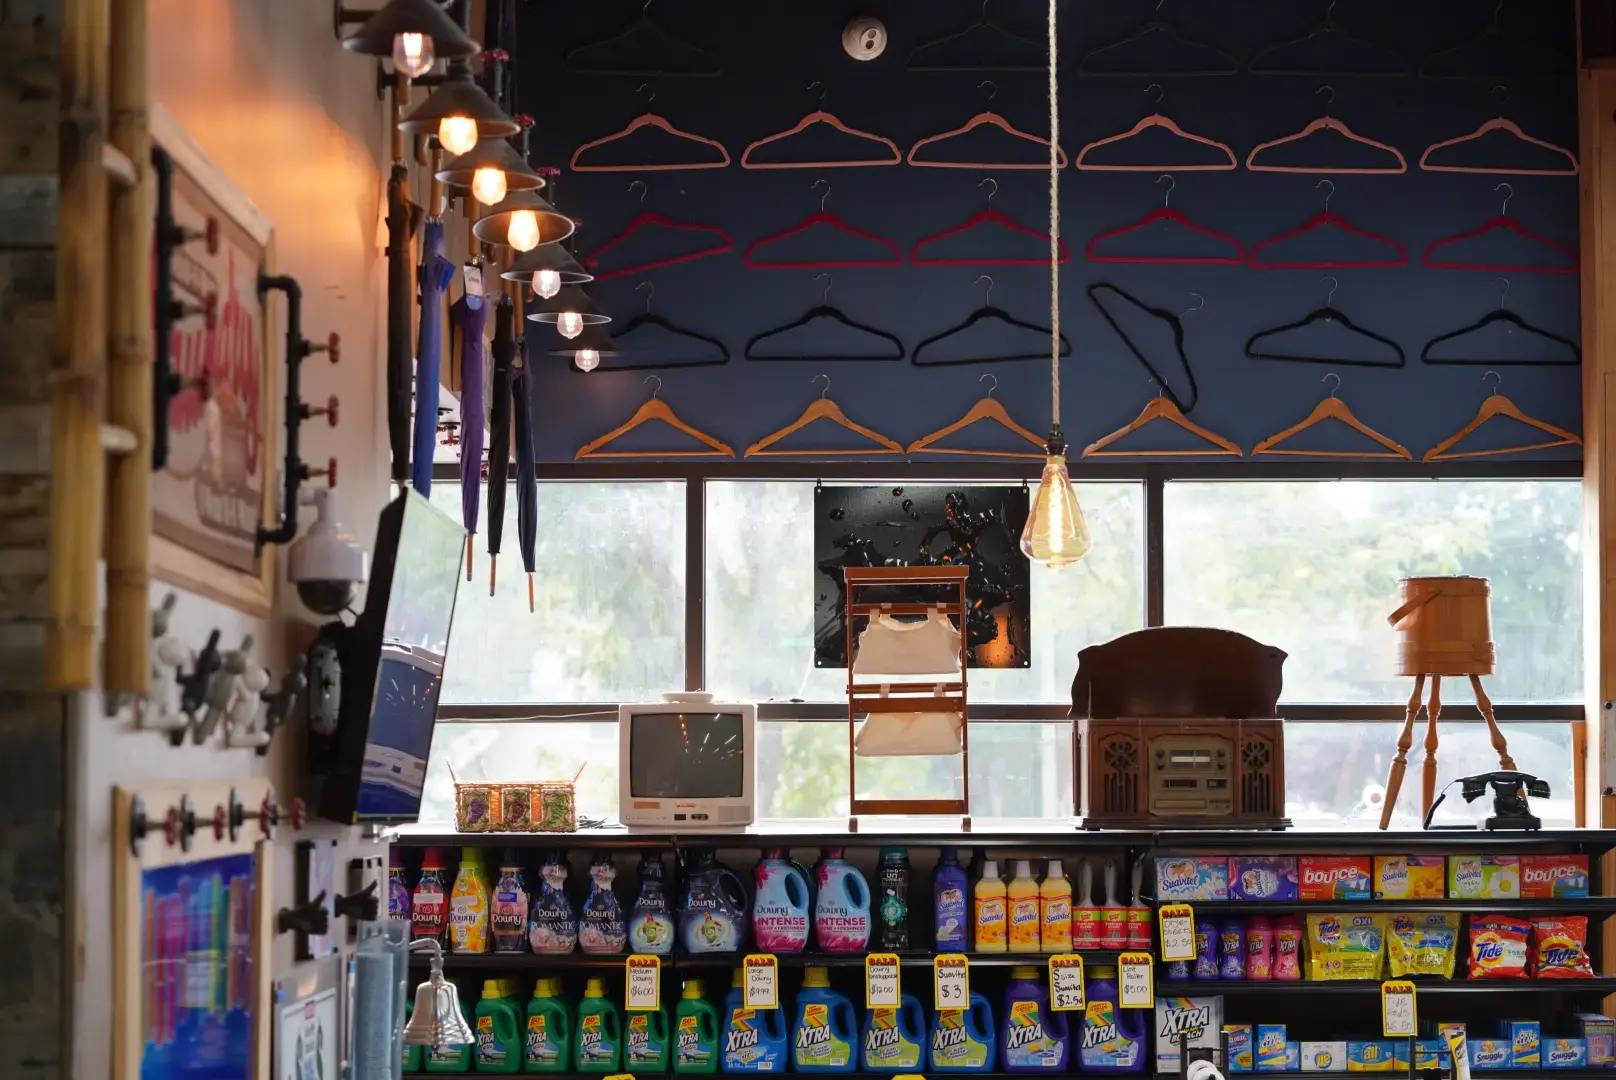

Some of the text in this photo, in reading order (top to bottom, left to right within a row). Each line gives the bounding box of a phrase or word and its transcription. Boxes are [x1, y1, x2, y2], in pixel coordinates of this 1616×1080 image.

[1303, 866, 1358, 885] bounce
[1381, 871, 1408, 883] Suavitel
[1456, 870, 1482, 882] Suavitel
[1524, 865, 1577, 883] bounce
[1162, 875, 1198, 892] Suavitel
[1253, 868, 1265, 898] Suavitel
[640, 898, 665, 907] Downy
[688, 898, 716, 909] Downy
[940, 900, 964, 911] Suavitel
[538, 908, 568, 919] Downy
[586, 908, 616, 919] Downy
[757, 905, 789, 916] Downy
[817, 905, 848, 916] Downy
[1161, 909, 1190, 917] SALE
[412, 912, 442, 925] Downy
[450, 913, 476, 924] Downy
[492, 913, 522, 925] Downy
[757, 917, 806, 926] INTENSE
[818, 917, 866, 926] INTENSE
[979, 913, 1004, 924] Suavitel
[1013, 913, 1037, 925] Suavitel
[1046, 912, 1070, 924] Suavitel
[1353, 917, 1372, 926] OXI
[531, 921, 575, 930] ROMANTIC
[580, 921, 624, 931] ROMANTIC
[1319, 921, 1340, 935] Tide
[1393, 918, 1414, 933] Tide
[1196, 940, 1208, 950] TRA
[1224, 940, 1239, 952] XTRA
[1280, 939, 1296, 952] XTRA
[1476, 942, 1503, 962] Tide
[1541, 949, 1578, 964] Tide
[628, 958, 658, 967] SALE
[746, 958, 775, 966] SALE
[867, 957, 897, 965] SALE
[936, 959, 965, 967] SALE
[1121, 956, 1150, 965] SALE
[747, 968, 764, 976] Large
[751, 975, 772, 984] Downy
[1385, 985, 1413, 993] SALE
[1160, 1006, 1209, 1038] XTRA
[477, 1033, 494, 1047] XTRA
[526, 1032, 547, 1047] XTRA
[580, 1032, 602, 1047] XTRA
[628, 1032, 649, 1047] XTRA
[678, 1033, 698, 1047] XTRA
[725, 1028, 758, 1052] XTRA
[797, 1024, 831, 1048] XTRA
[866, 1026, 899, 1051] XTRA
[934, 1026, 966, 1050] XTRA
[1007, 1023, 1042, 1049] XTRA
[1082, 1023, 1116, 1049] XTRA
[1170, 1028, 1203, 1043] BLACH
[1363, 1044, 1379, 1060] all
[1476, 1051, 1503, 1063] Snuggle
[1550, 1050, 1578, 1062] Snuggle
